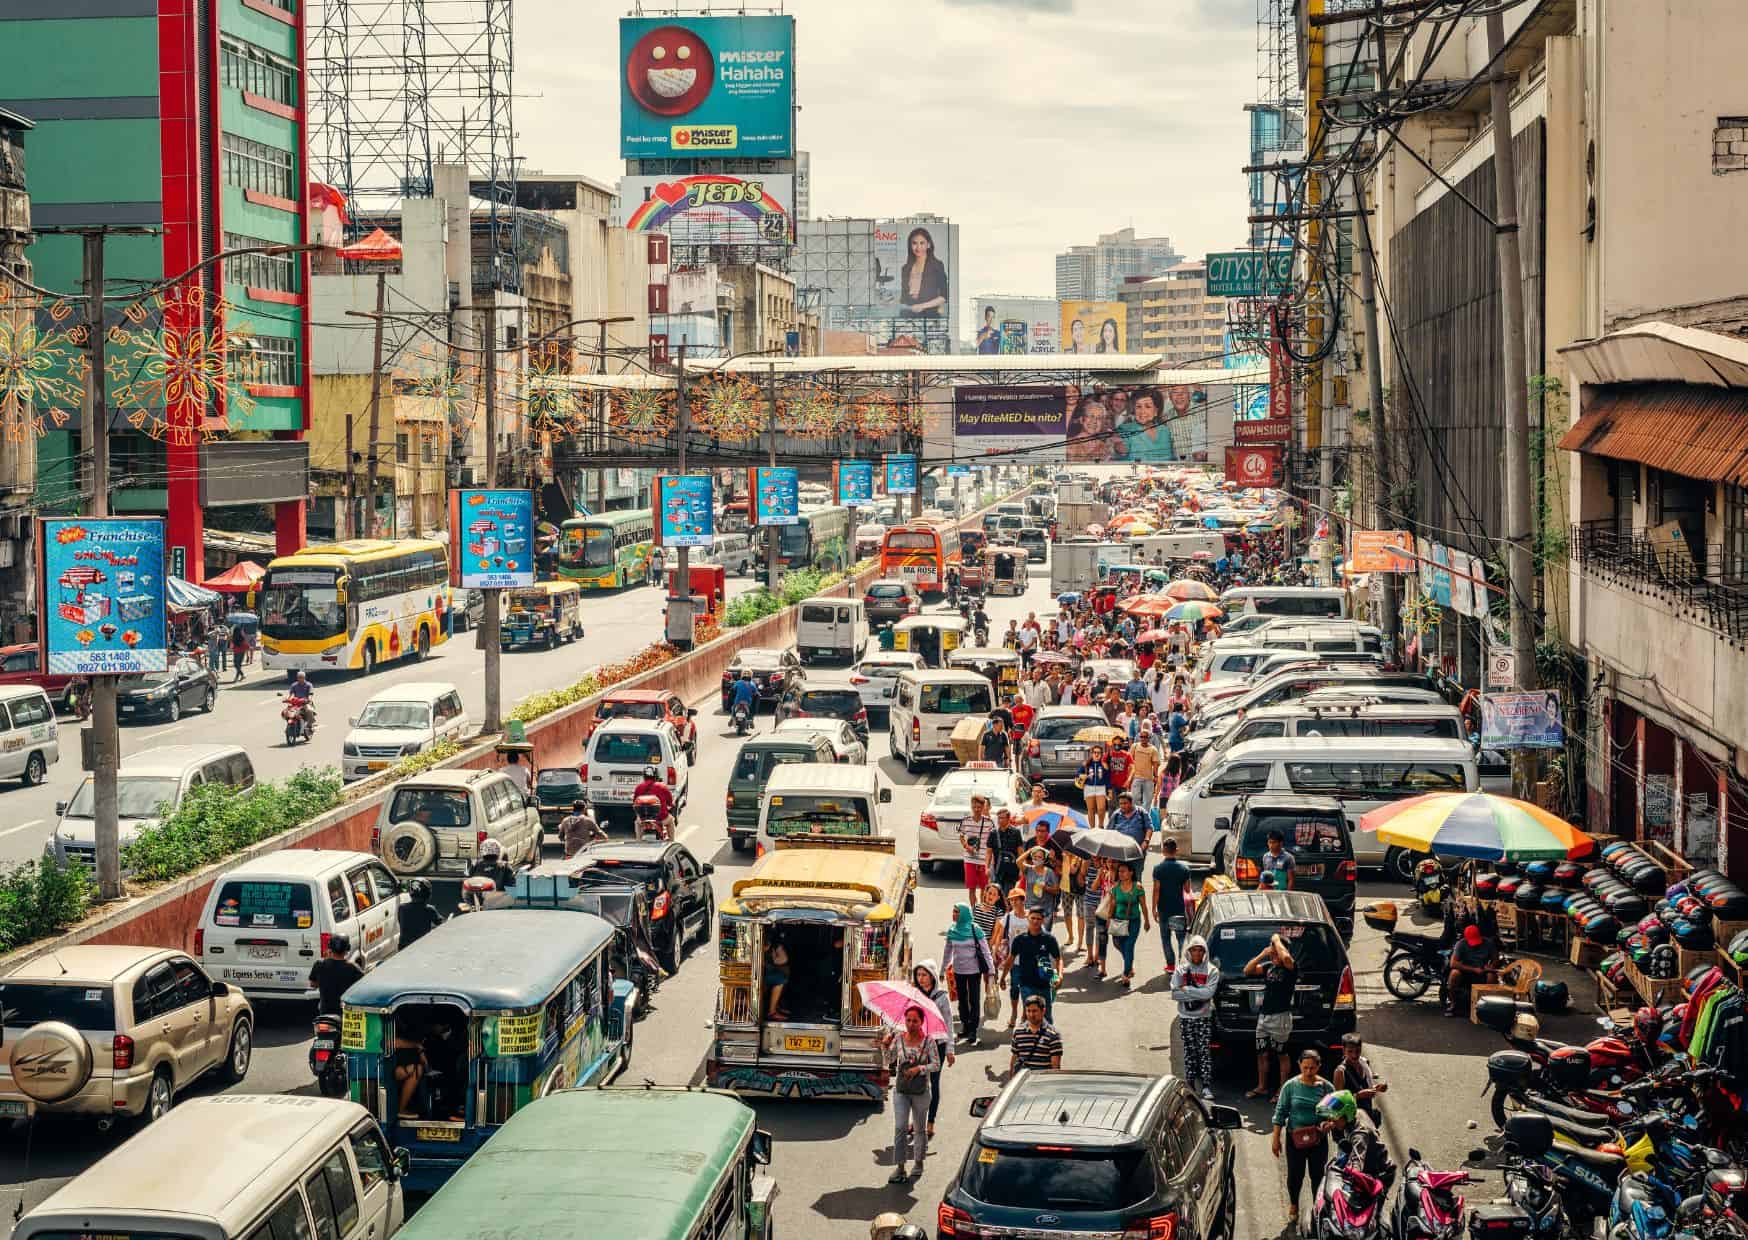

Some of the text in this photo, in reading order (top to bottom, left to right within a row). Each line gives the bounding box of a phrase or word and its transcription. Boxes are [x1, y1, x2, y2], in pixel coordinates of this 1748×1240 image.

[720, 64, 784, 81] Hahaha
[690, 137, 733, 145] Donut
[687, 180, 764, 207] JED'S
[765, 218, 784, 231] 24
[959, 412, 1063, 425] May RiteMED ba nito?
[1235, 423, 1291, 437] PAWNSHOP
[89, 529, 151, 543] Franchise
[903, 566, 937, 575] MA ROSE
[90, 651, 130, 662] 563 1408
[77, 663, 99, 674] 0927
[223, 967, 232, 978] UV
[232, 969, 253, 981] Express
[254, 969, 273, 980] Service
[808, 1039, 822, 1049] 122
[1573, 1165, 1614, 1194] SUZU
